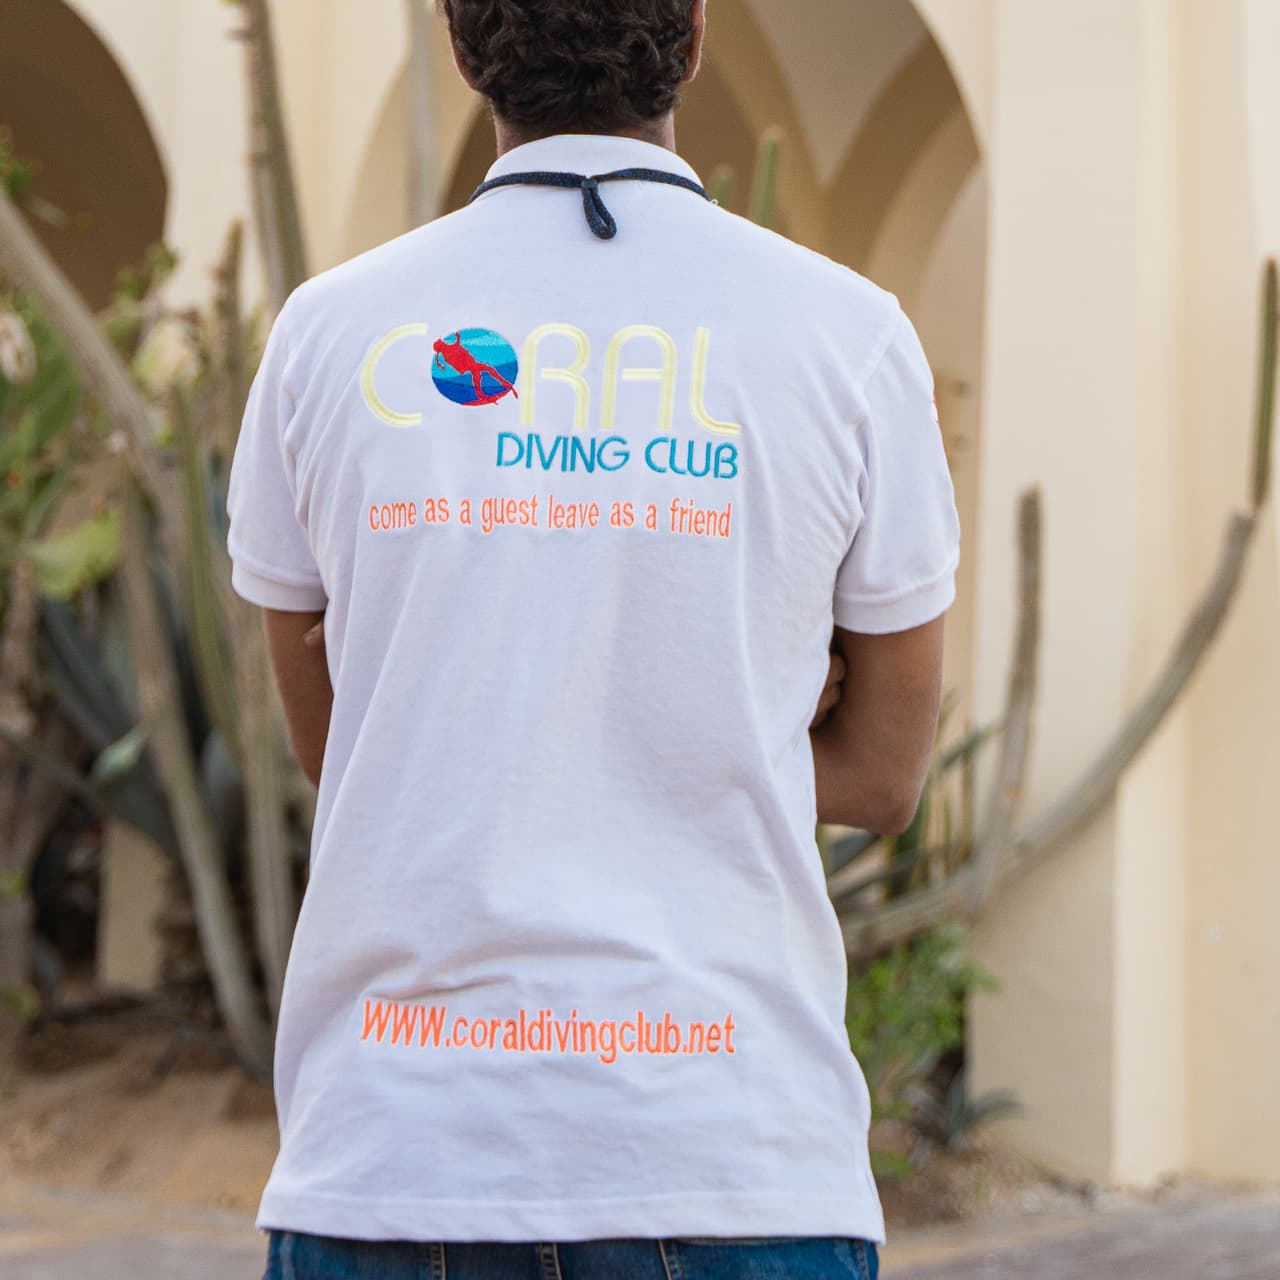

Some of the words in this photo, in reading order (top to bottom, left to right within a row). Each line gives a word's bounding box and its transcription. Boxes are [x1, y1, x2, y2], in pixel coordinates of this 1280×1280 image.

[496, 431, 631, 474] DIVING
[644, 436, 739, 480] CLUB
[369, 501, 417, 532] come
[424, 496, 450, 523] as
[459, 498, 471, 526] a
[481, 494, 538, 534] guest
[548, 495, 599, 530] leave
[609, 501, 635, 528] as
[645, 503, 657, 531] a
[669, 497, 732, 538] friend
